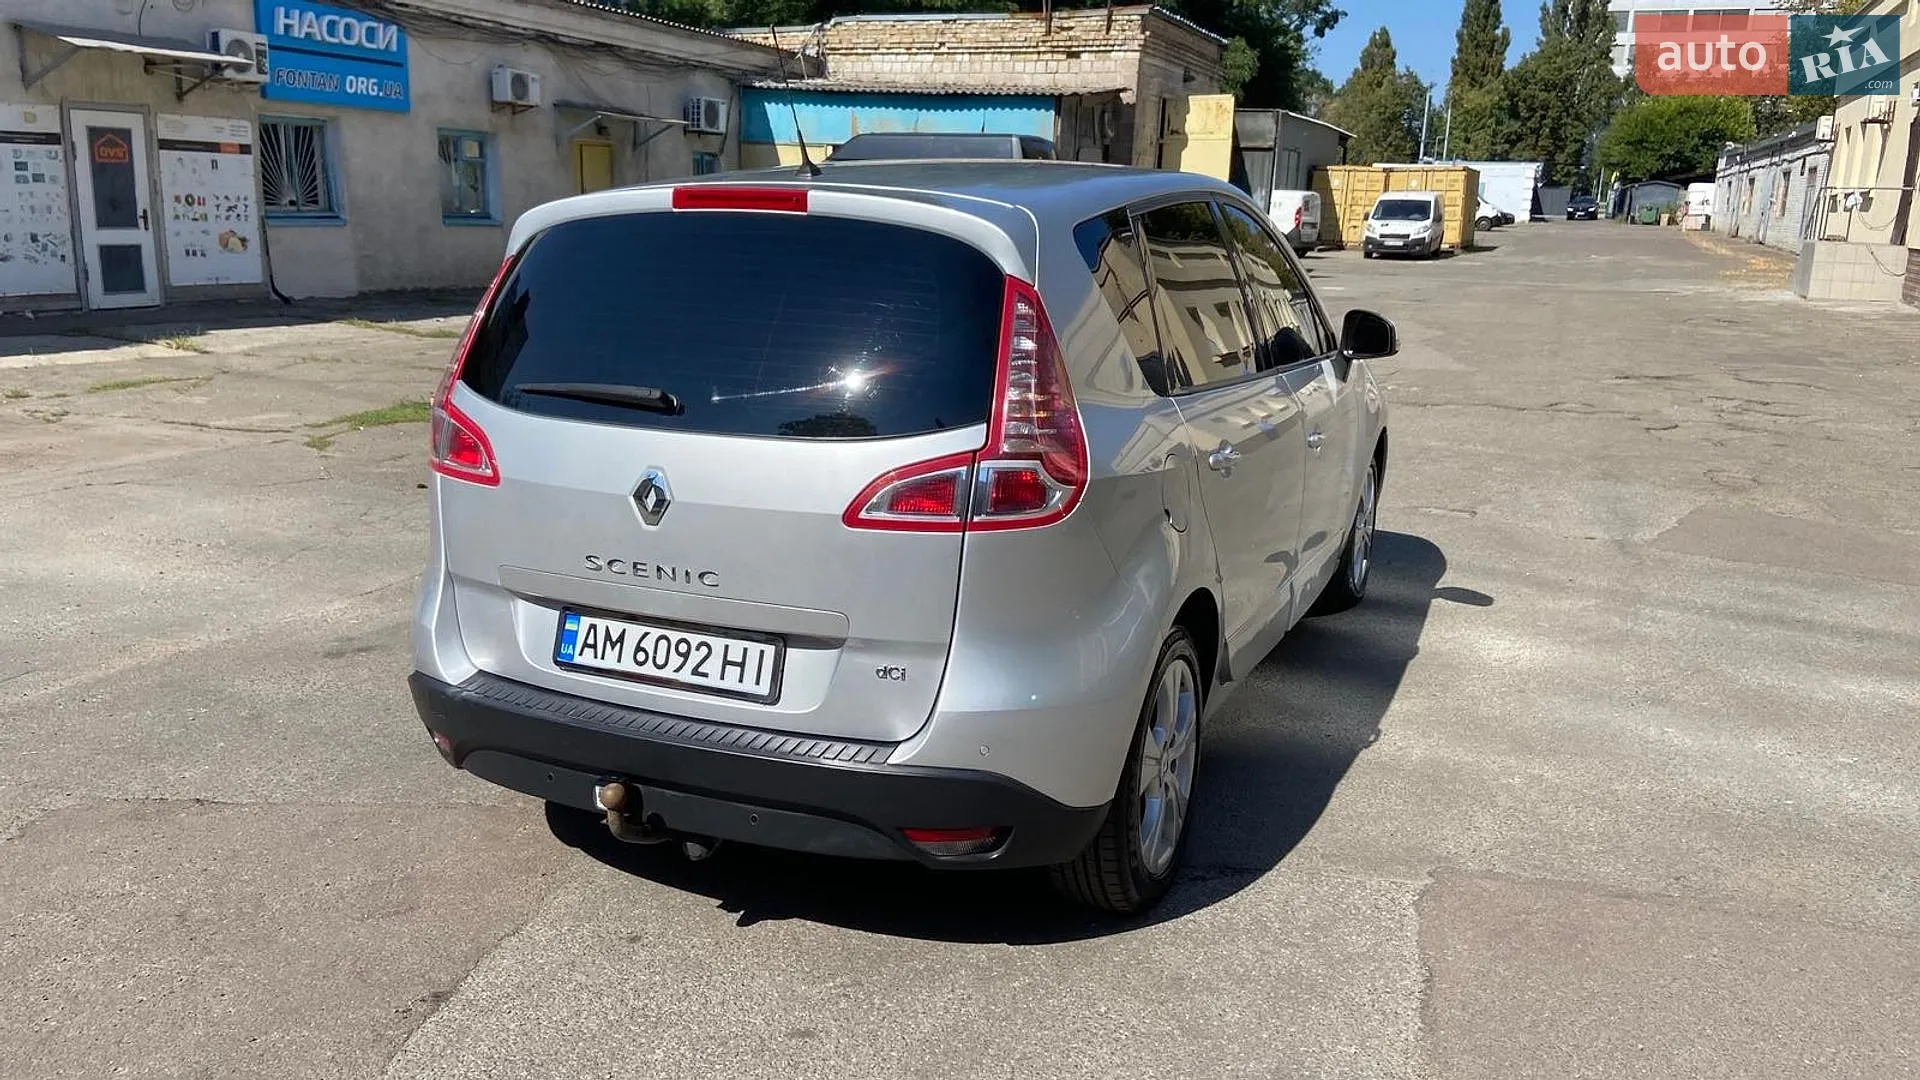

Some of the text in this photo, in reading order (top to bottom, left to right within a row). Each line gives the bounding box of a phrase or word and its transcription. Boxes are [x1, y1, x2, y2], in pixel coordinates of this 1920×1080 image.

[273, 6, 398, 52] НАСОСИ
[275, 67, 403, 100] FONTAN ORG.UA
[585, 554, 719, 587] SCENIC
[561, 643, 574, 655] UA
[578, 623, 765, 686] AM 6092 HI
[875, 665, 906, 681] dCi
